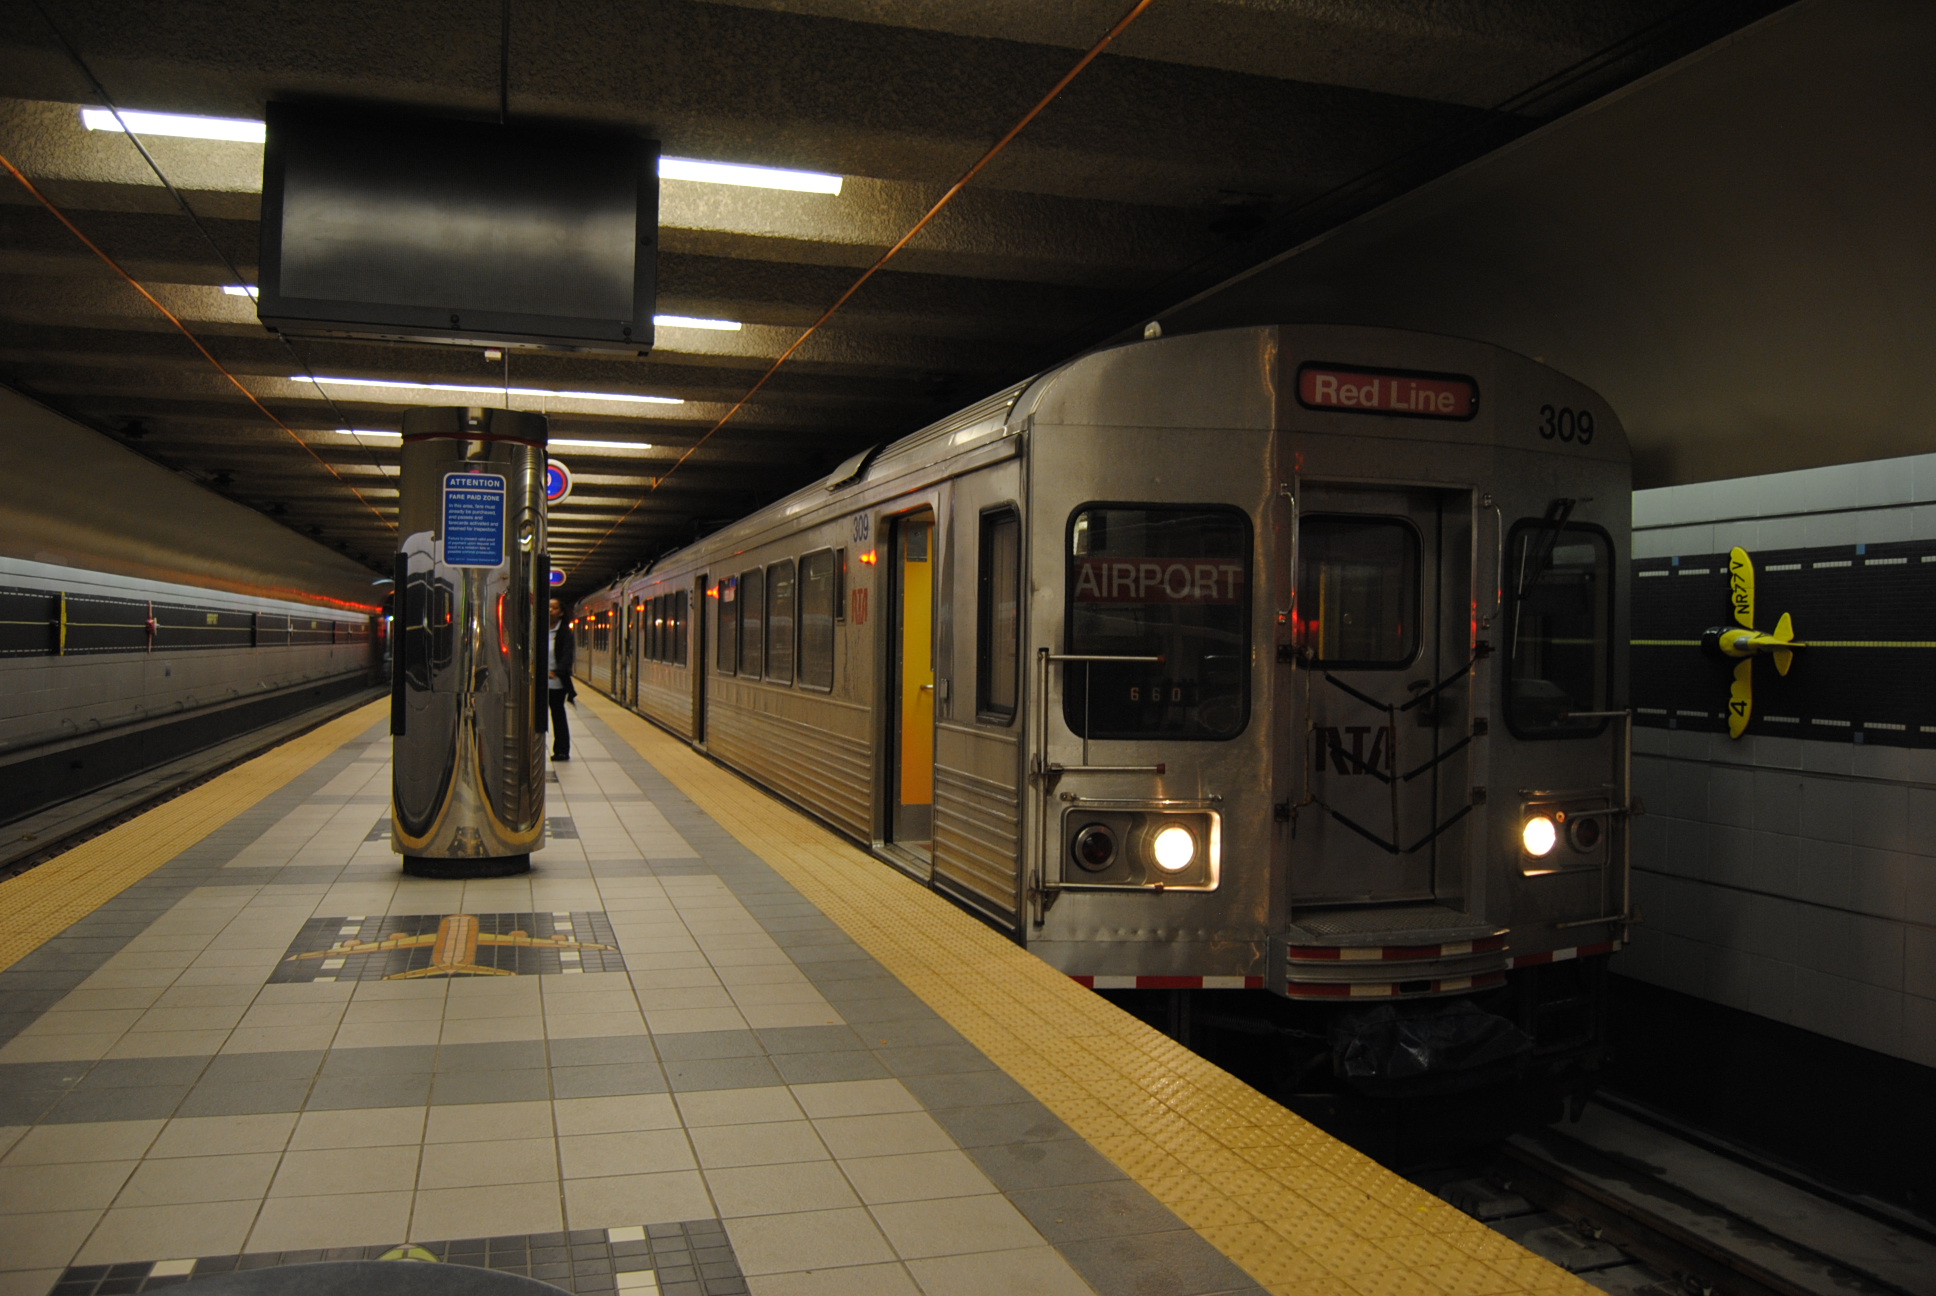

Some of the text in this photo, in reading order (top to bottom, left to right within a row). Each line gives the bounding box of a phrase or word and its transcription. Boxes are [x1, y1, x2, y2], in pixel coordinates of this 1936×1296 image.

[1315, 375, 1455, 411] Red Line
[1538, 404, 1594, 445] 309
[450, 479, 500, 487] ATTENTION
[854, 514, 869, 542] 309
[1075, 563, 1243, 600] AIRPORT
[852, 588, 868, 624] RTA
[1731, 700, 1747, 716] 4
[1314, 726, 1396, 776] RTA
